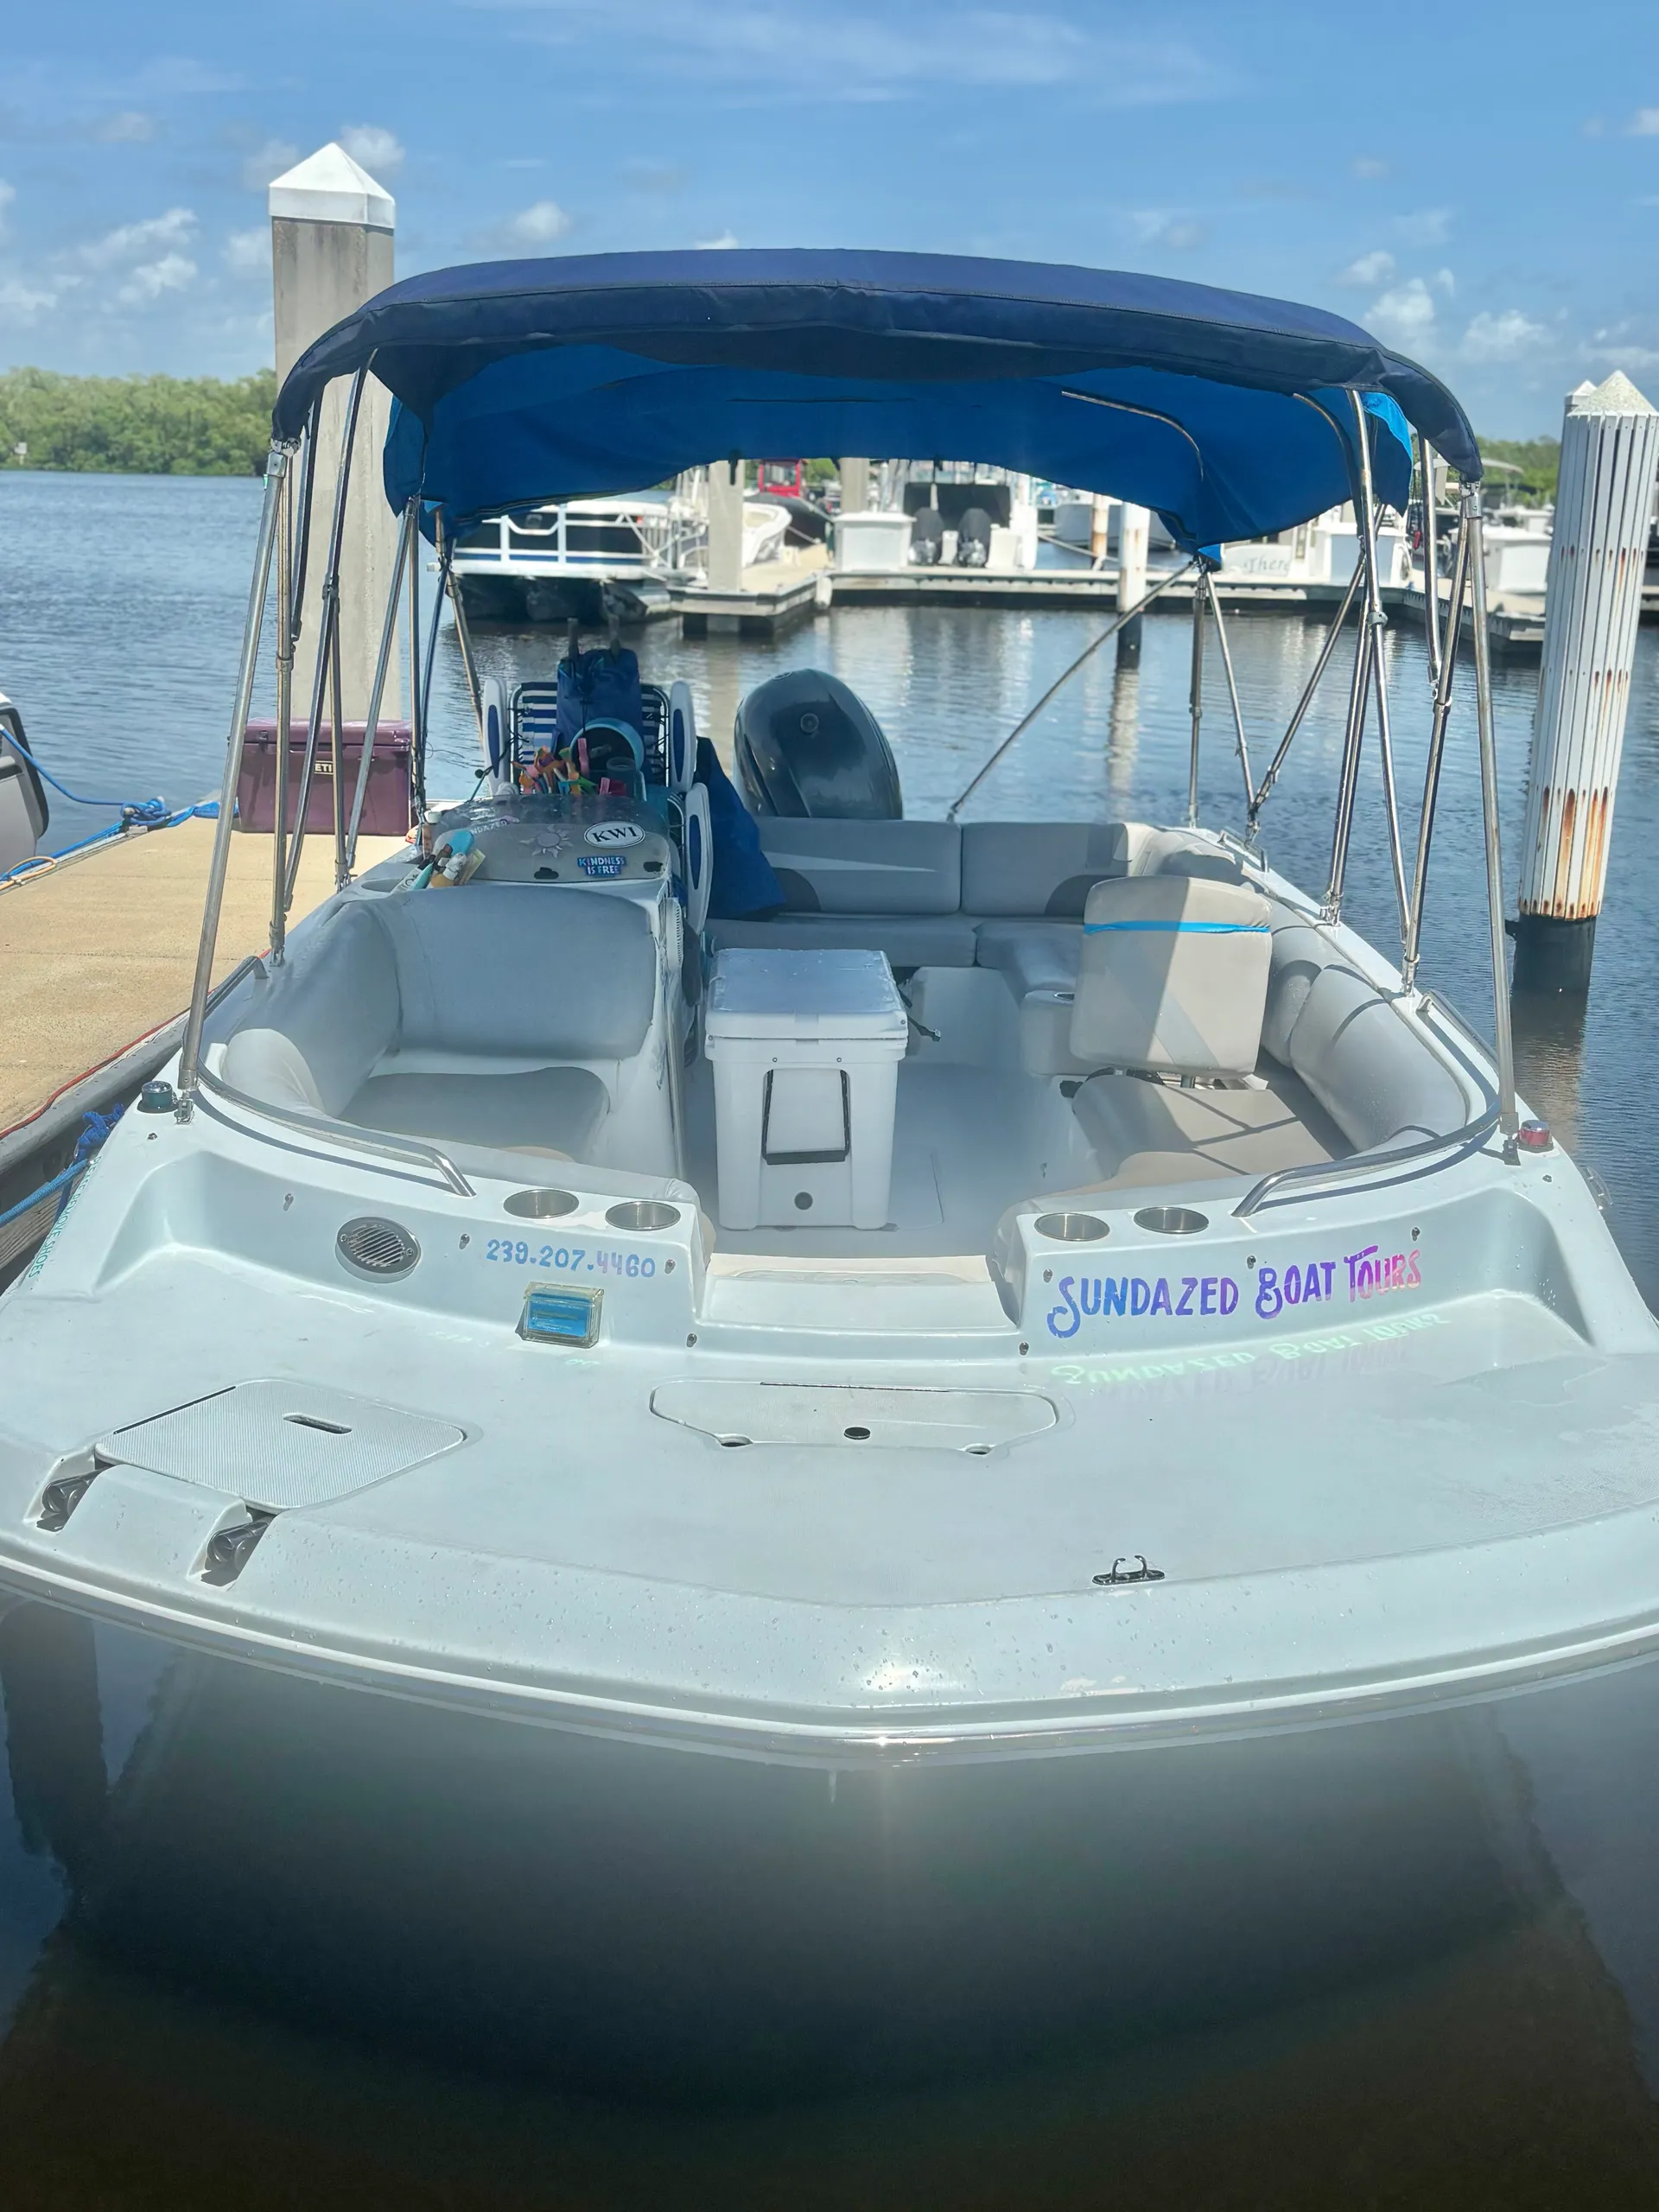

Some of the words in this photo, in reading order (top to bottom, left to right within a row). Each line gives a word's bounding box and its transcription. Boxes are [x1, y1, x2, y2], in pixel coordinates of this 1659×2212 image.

[314, 763, 333, 772] ETI
[592, 827, 638, 842] KWI
[577, 856, 625, 867] KINDNESS
[588, 866, 595, 874] IS
[598, 865, 620, 874] FREE
[28, 1240, 55, 1279] SHOES
[486, 1239, 656, 1278] 239.207.4460
[1046, 1275, 1239, 1338] SUNDAZED
[1255, 1261, 1336, 1320] BOAT
[1343, 1245, 1422, 1303] TOURS
